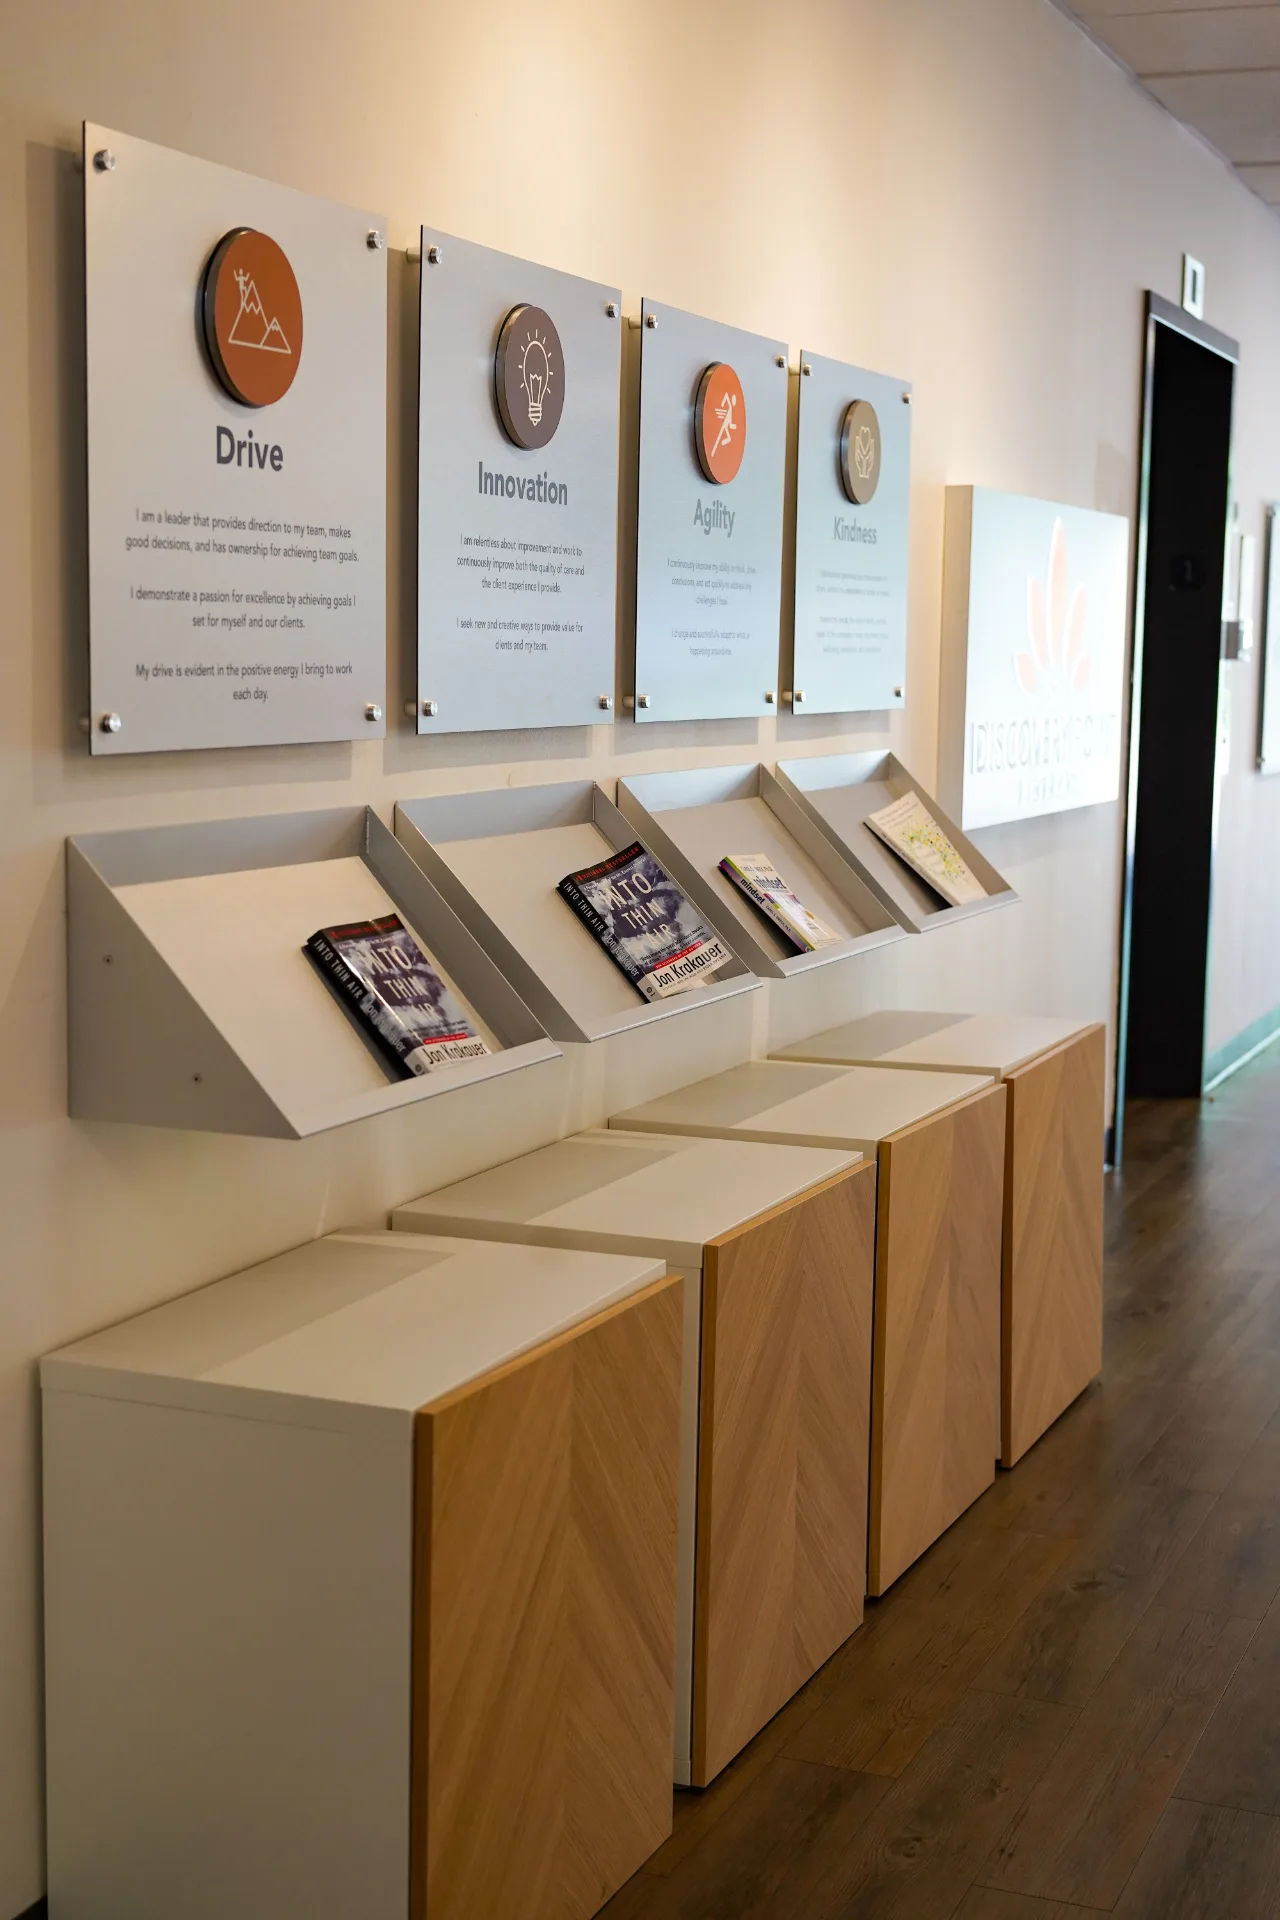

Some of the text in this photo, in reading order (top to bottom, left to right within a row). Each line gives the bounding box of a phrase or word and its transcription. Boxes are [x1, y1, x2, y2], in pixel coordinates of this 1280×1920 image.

[216, 425, 284, 472] Drive
[478, 461, 568, 506] Innovation
[142, 512, 155, 522] am
[164, 509, 191, 525] leader
[193, 513, 210, 527] that
[212, 516, 246, 532] provides
[248, 517, 281, 533] direction
[284, 522, 292, 534] to
[294, 525, 305, 538] my
[307, 525, 327, 538] team,
[329, 525, 351, 538] makes
[693, 498, 736, 538] Agility
[833, 516, 878, 544] Kindness
[125, 534, 360, 564] good decisions, and has ownership for achieving team goals.
[136, 584, 190, 600] demonstrate
[200, 589, 230, 606] passion
[232, 588, 243, 603] for
[245, 591, 285, 605] excellence
[287, 592, 297, 608] by
[298, 593, 332, 609] achieving
[333, 593, 352, 609] goals
[192, 613, 306, 631] set for myself and our clients.
[135, 663, 149, 681] My
[152, 662, 174, 677] drive
[176, 664, 182, 677] is
[184, 663, 215, 677] evident
[217, 664, 224, 676] in
[226, 663, 239, 676] the
[241, 664, 272, 679] positive
[273, 666, 299, 678] energy
[305, 662, 325, 677] bring
[326, 663, 334, 674] to
[336, 660, 353, 674] work
[232, 687, 269, 702] each day.
[599, 872, 653, 911] INTO
[739, 878, 766, 905] mindset
[563, 882, 581, 901] INTO
[577, 899, 594, 919] THIN
[589, 917, 605, 932] AIR
[620, 898, 666, 930] THIN
[645, 923, 678, 946] AIR
[314, 938, 334, 961] INTO
[330, 959, 351, 982] THIN
[346, 980, 365, 1000] AIR
[359, 944, 413, 976] INTO
[653, 972, 675, 988] Jon
[669, 943, 723, 979] Krakauer
[383, 975, 429, 1000] THIN
[422, 1042, 488, 1065] Jon Krakauer
